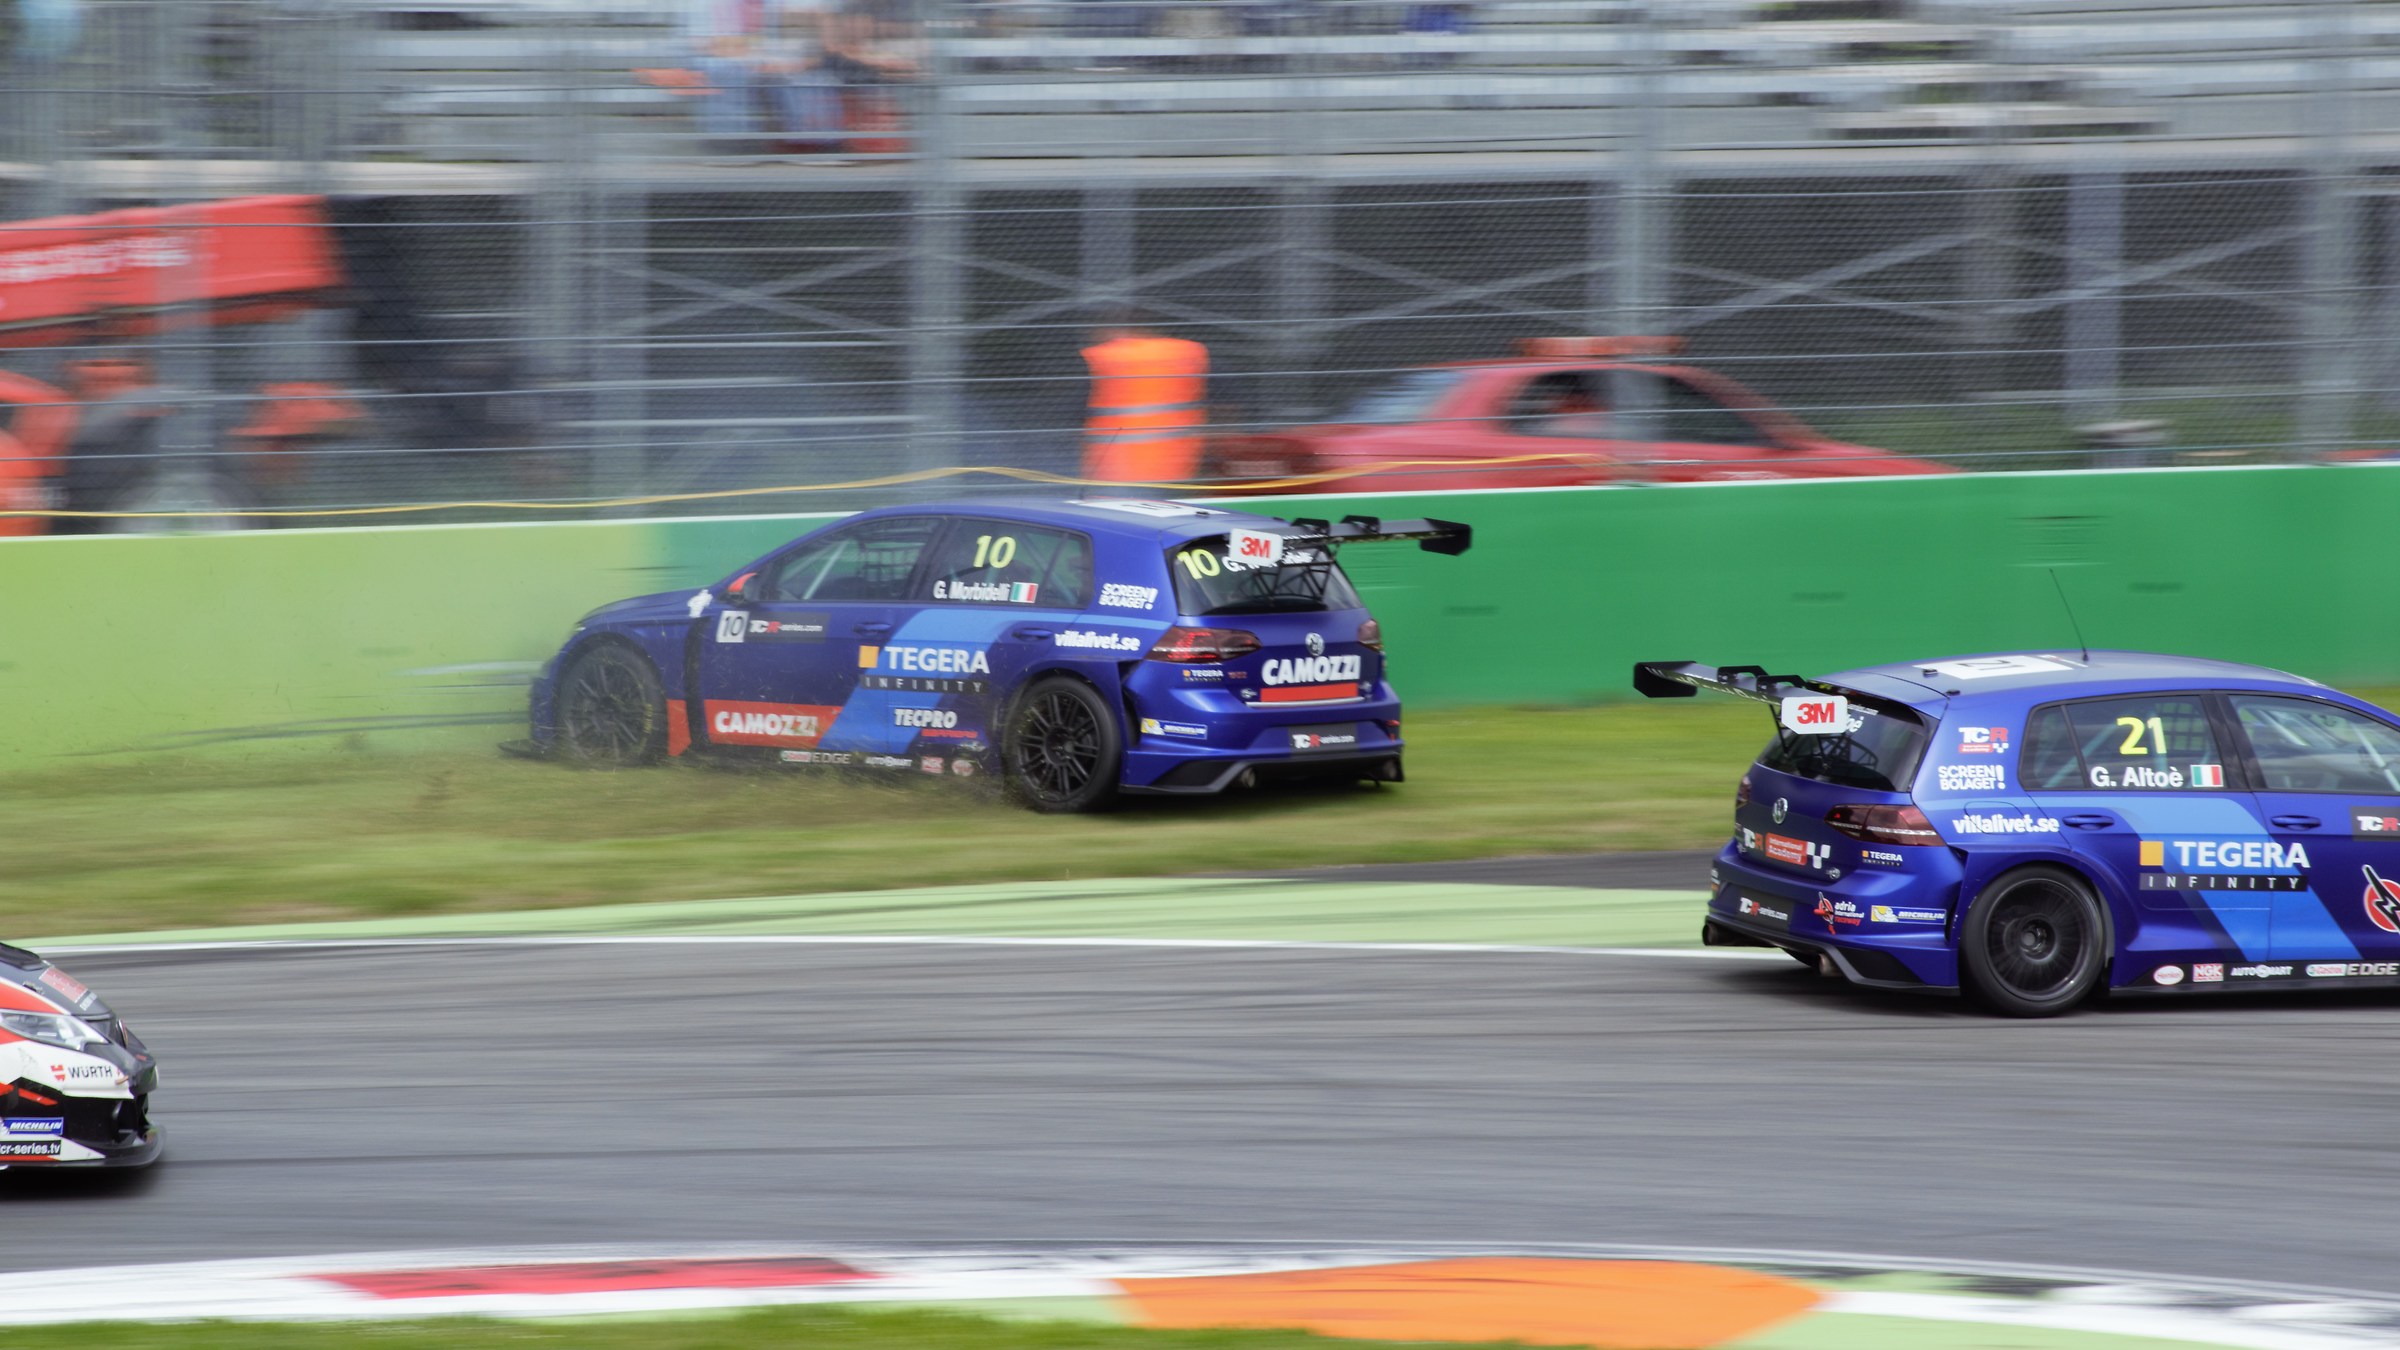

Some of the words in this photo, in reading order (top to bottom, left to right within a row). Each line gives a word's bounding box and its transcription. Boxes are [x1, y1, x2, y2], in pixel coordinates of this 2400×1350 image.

[973, 534, 1017, 569] 10
[1240, 536, 1271, 558] 3M
[1176, 548, 1221, 580] 10
[721, 615, 744, 637] 10
[1054, 629, 1141, 651] villalivet.se
[884, 646, 991, 674] TEGERA
[1261, 654, 1362, 686] CAMOZZI
[865, 677, 983, 693] INFINITY
[714, 710, 819, 737] CAMOZZI
[893, 708, 959, 729] TECPRO
[1797, 702, 1835, 724] 3M
[1958, 726, 2009, 743] TCR
[2116, 716, 2167, 755] 21
[811, 752, 851, 764] EDGE
[1938, 764, 1996, 779] SCREEN
[2090, 765, 2117, 788] G.
[2121, 765, 2184, 788] Altoè
[1940, 777, 1997, 791] BOLAGET
[1952, 813, 2060, 834] villalivet.se
[1743, 827, 1764, 851] TCR
[1869, 850, 1903, 862] TEGERA
[2173, 841, 2311, 869] TEGERA
[2149, 875, 2301, 890] INFINITY
[1834, 900, 1856, 912] adria
[2193, 964, 2223, 977] NGK
[2346, 963, 2400, 976] EDGE
[67, 1064, 113, 1079] WÜRTH
[9, 1121, 62, 1131] MICHELIN
